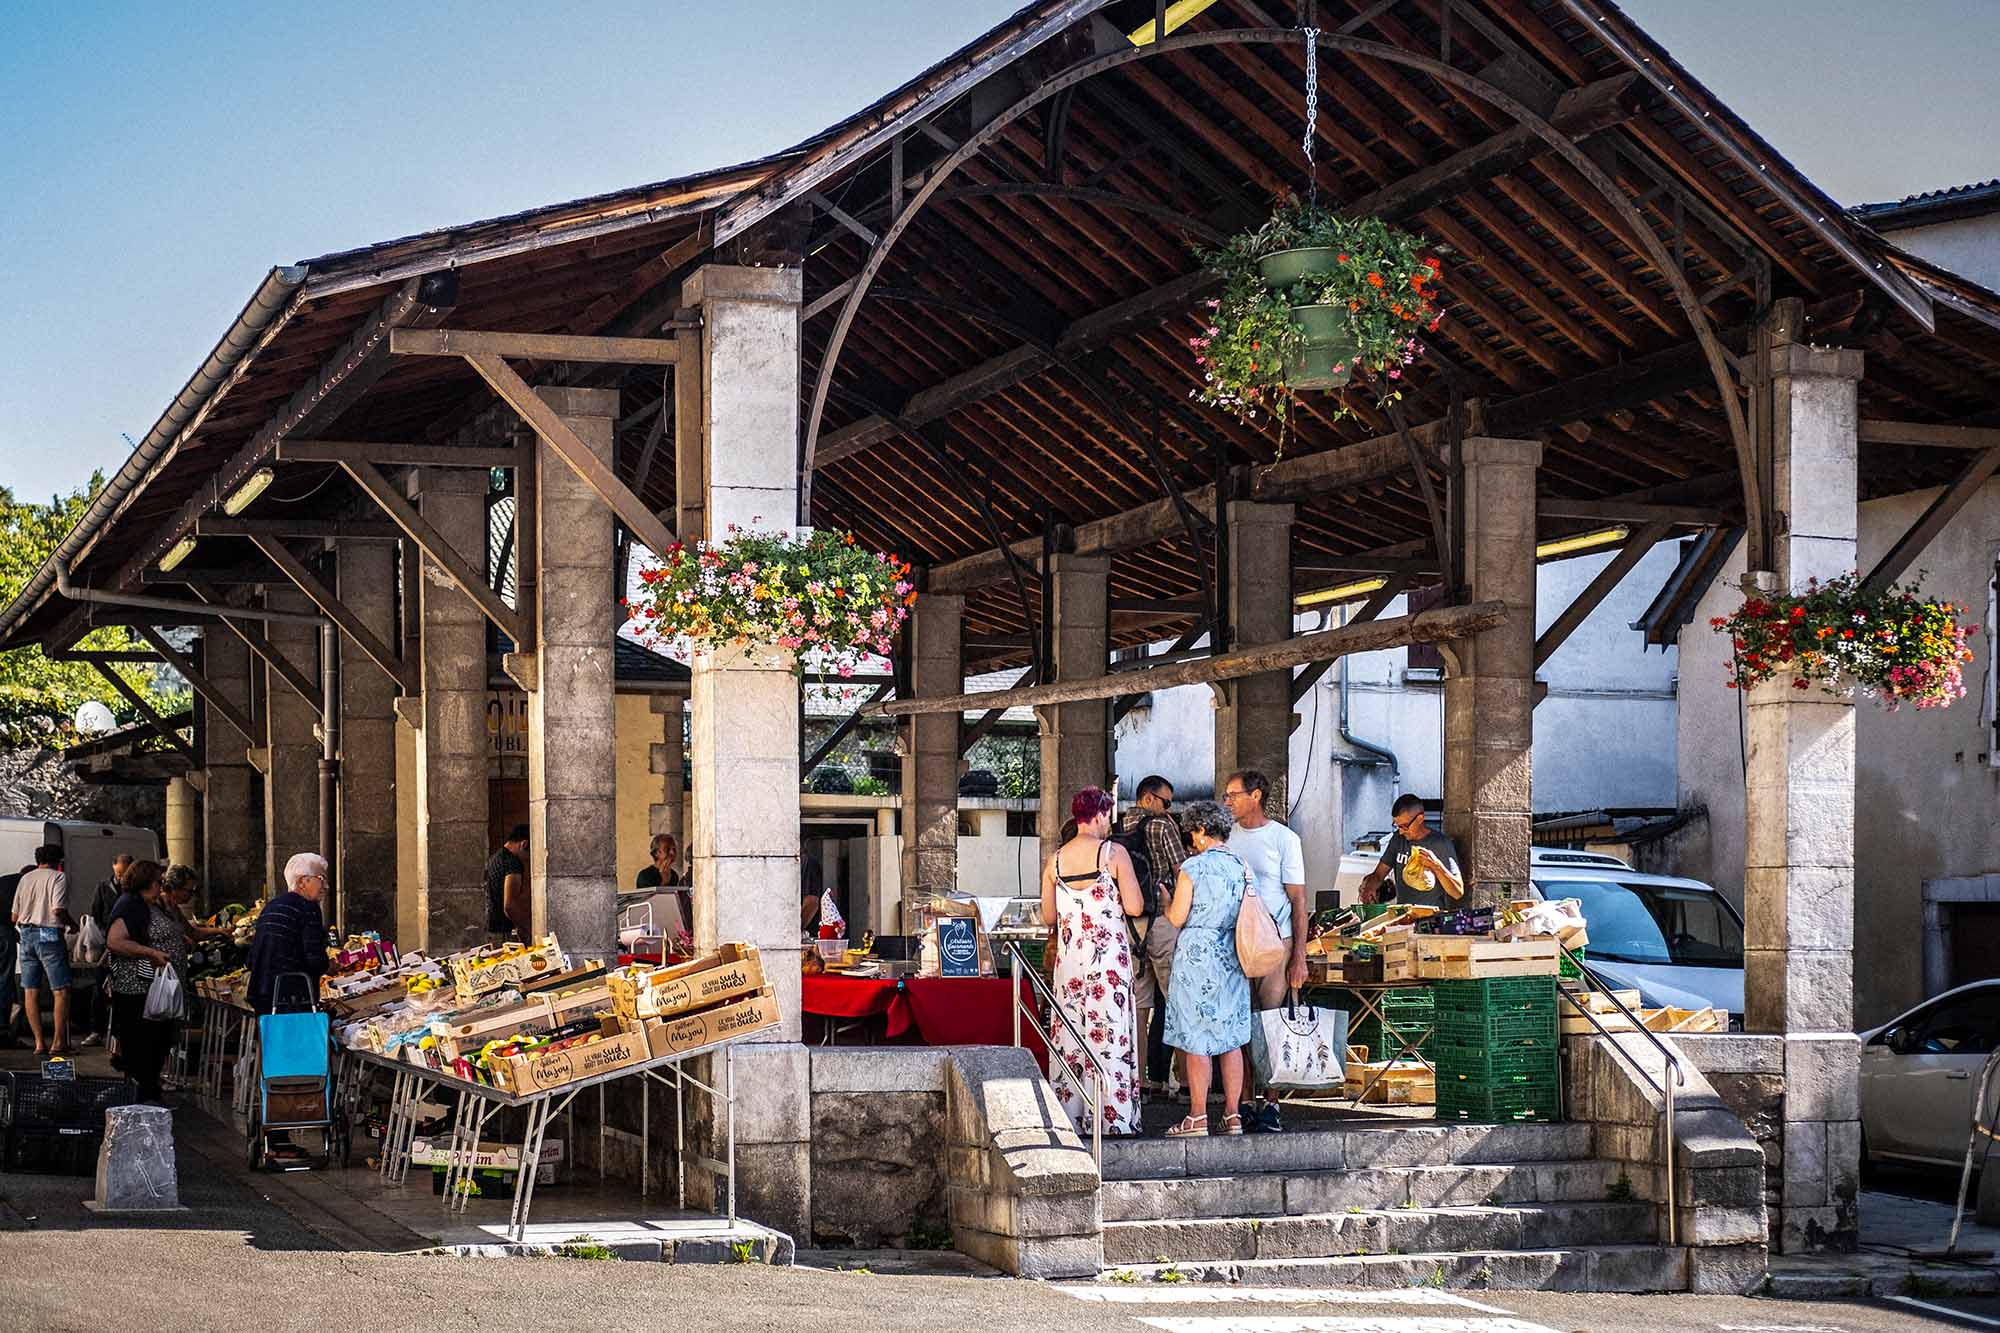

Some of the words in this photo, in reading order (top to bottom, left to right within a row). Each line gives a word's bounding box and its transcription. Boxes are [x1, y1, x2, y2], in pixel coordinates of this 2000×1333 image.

[719, 969, 738, 984] sud
[720, 973, 747, 990] ouest
[656, 992, 687, 1007] Majou
[735, 1006, 754, 1022] sud
[736, 1010, 763, 1027] ouest
[671, 1028, 704, 1041] Majou
[602, 1043, 622, 1058] sud
[603, 1047, 631, 1064] ouest
[536, 1065, 569, 1079] Majou
